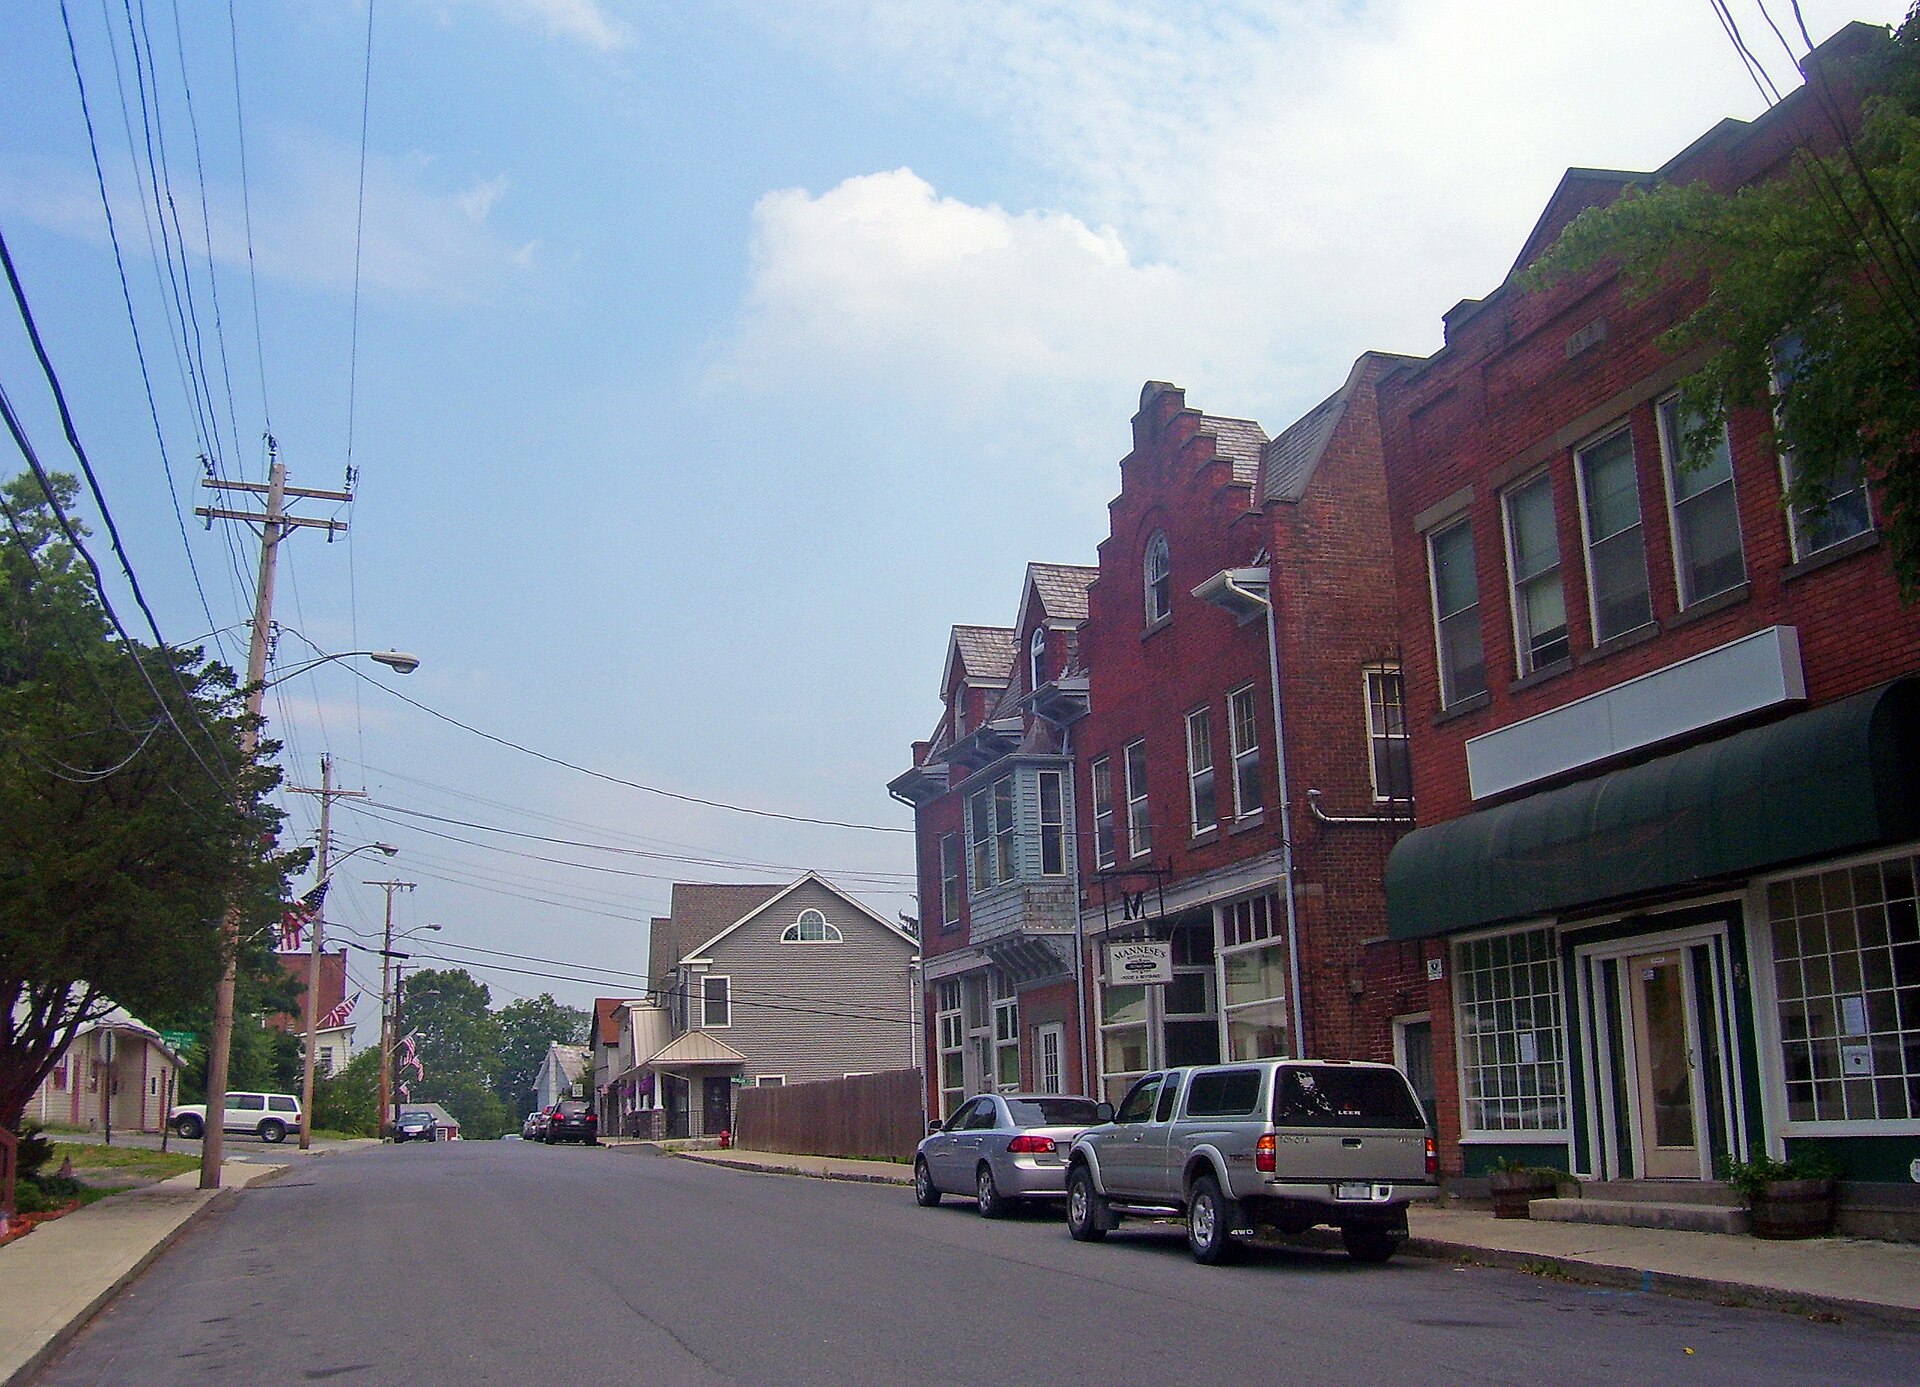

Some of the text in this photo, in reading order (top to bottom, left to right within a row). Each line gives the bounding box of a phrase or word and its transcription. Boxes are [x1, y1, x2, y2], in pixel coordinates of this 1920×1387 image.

[1121, 890, 1146, 920] M
[1114, 946, 1167, 960] MANNESE'S
[1230, 1229, 1254, 1237] 4WD
